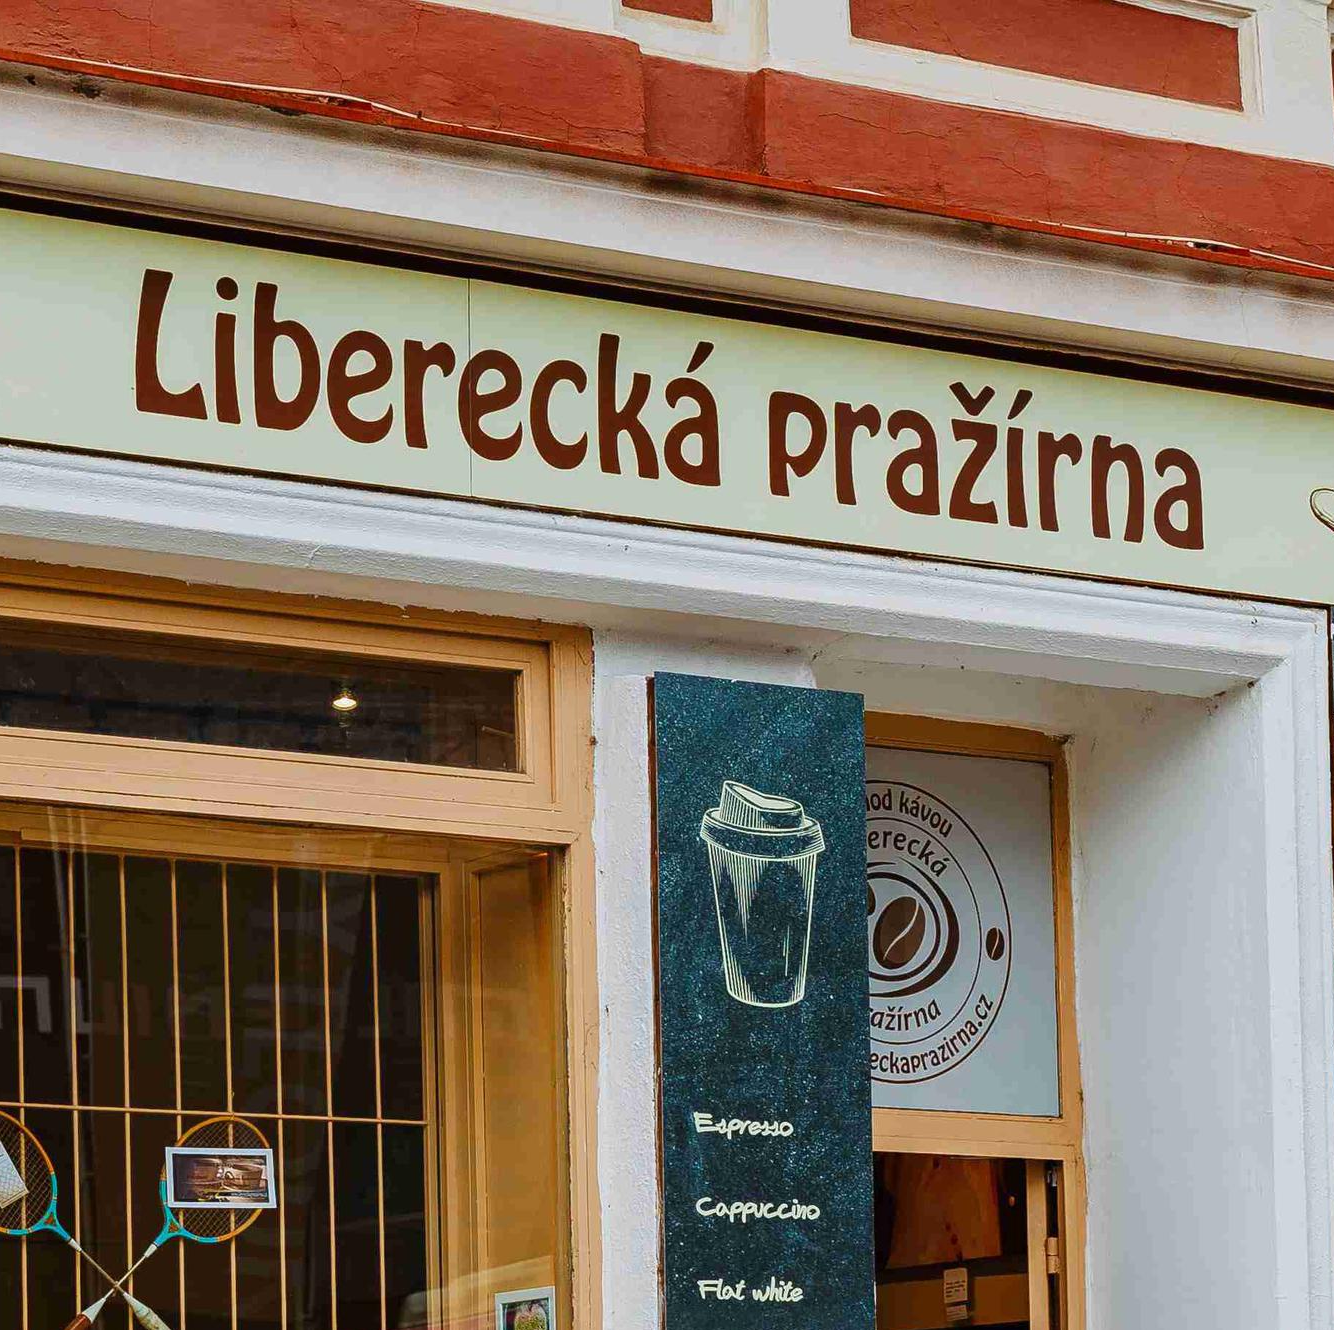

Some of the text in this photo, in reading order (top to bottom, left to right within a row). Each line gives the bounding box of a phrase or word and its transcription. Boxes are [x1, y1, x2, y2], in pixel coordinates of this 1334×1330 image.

[134, 267, 1206, 551] Liberecká pražírna
[899, 791, 954, 838] kávou
[868, 828, 949, 878] erecká
[693, 1111, 794, 1140] Espresso
[695, 1196, 821, 1224] Cappuccino
[697, 1276, 804, 1302] Flat white
